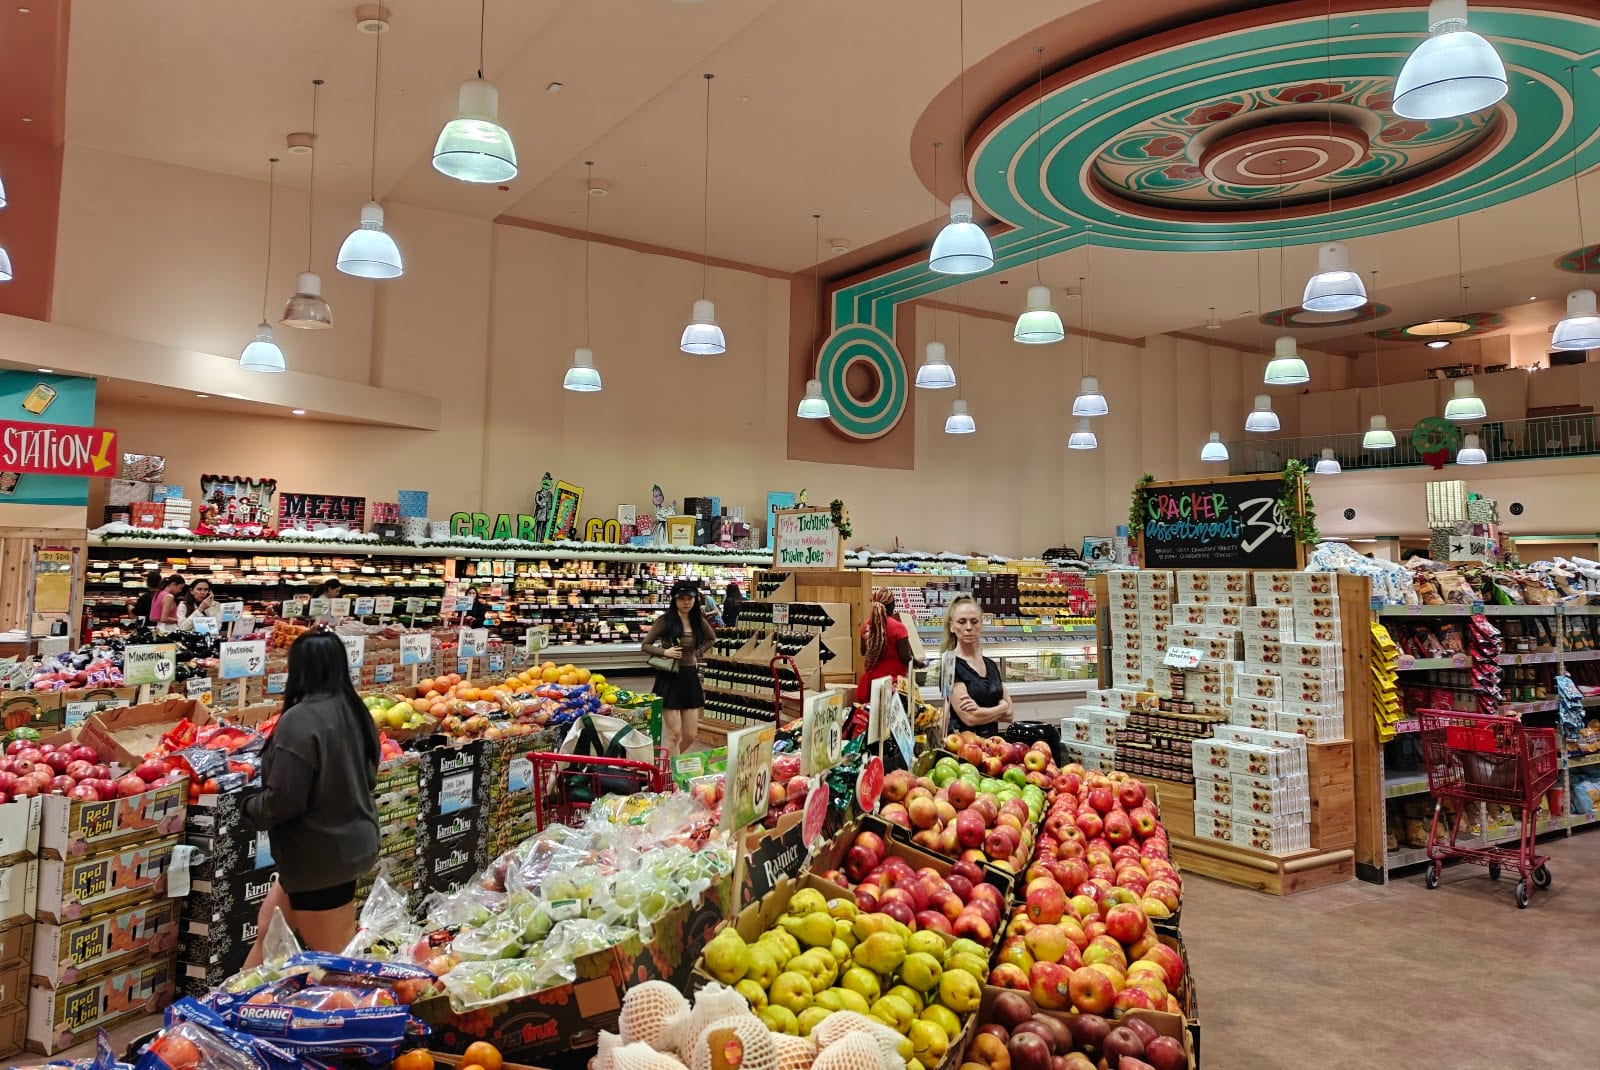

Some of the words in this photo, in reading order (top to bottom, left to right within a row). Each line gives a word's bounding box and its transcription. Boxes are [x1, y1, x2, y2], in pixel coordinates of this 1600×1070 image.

[284, 494, 360, 520] MEAT
[1148, 492, 1228, 520] CRACKER
[449, 512, 536, 542] GRAB
[584, 518, 620, 544] GO
[781, 548, 804, 563] Trader
[1084, 541, 1116, 561] EGGS
[86, 803, 110, 822] Red
[79, 864, 102, 884] Red
[764, 844, 798, 888] Rainier
[76, 927, 99, 949] Red
[71, 989, 94, 1012] Red
[240, 1007, 290, 1020] ORGANIC
